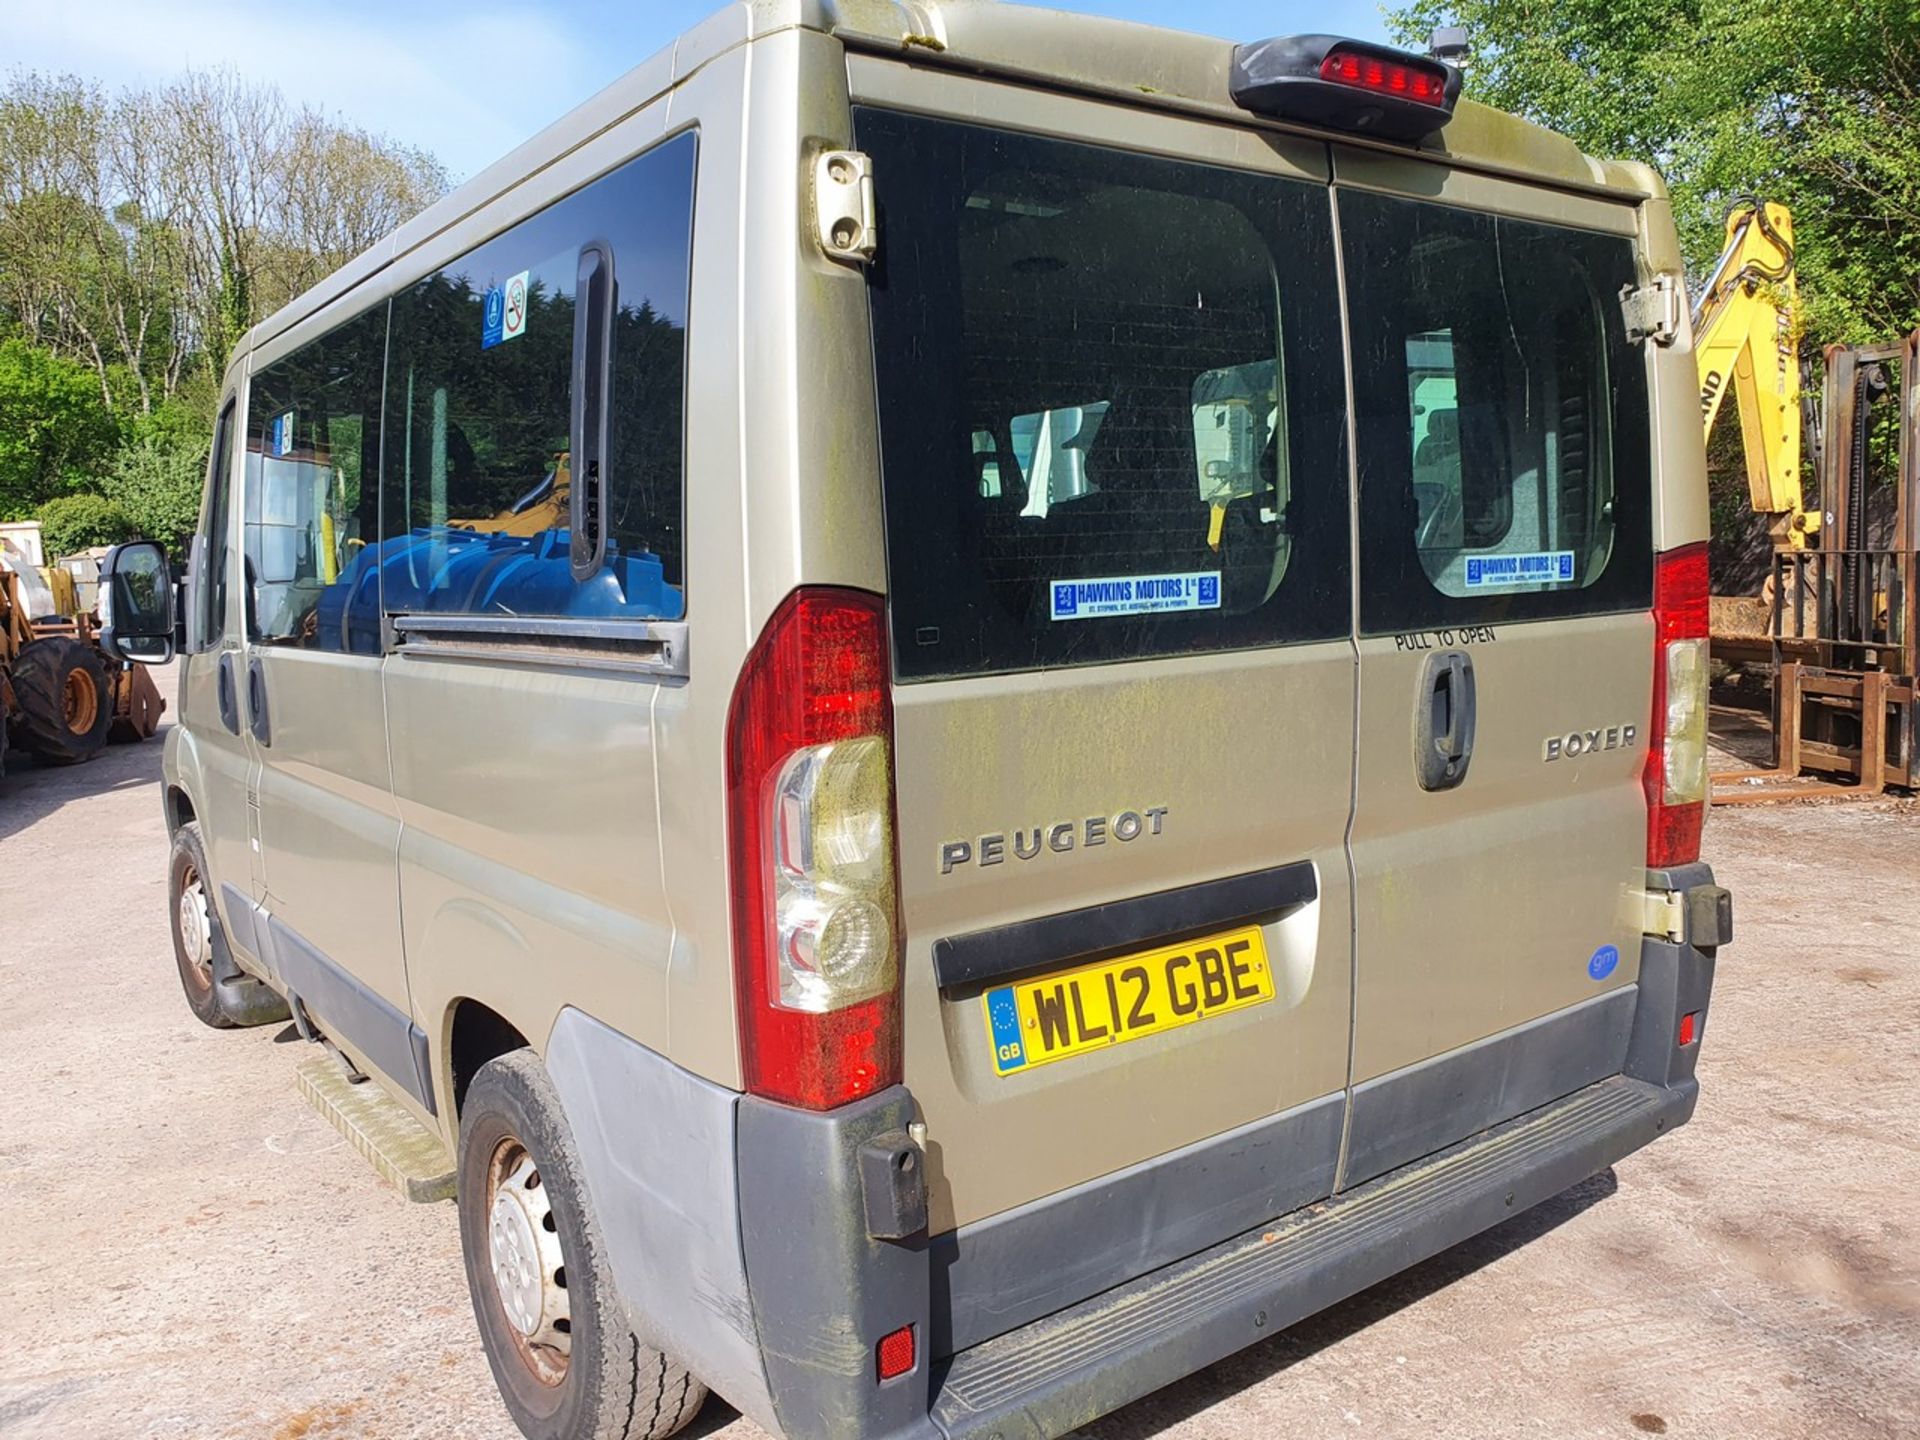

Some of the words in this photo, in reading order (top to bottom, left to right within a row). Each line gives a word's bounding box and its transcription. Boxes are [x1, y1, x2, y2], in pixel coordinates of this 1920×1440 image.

[1482, 557, 1517, 575] HAWKINS
[1520, 555, 1549, 573] MOTORS
[1078, 581, 1132, 604] HAWKINS
[1136, 578, 1182, 599] MOTORS
[1394, 632, 1432, 652] PULL
[1437, 629, 1455, 647] TO
[1459, 626, 1497, 644] OPEN
[1543, 725, 1636, 763] BOXER
[940, 807, 1168, 874] PEUGEOT
[1033, 966, 1155, 1052] WL12
[1165, 940, 1260, 1017] GBE
[1000, 1042, 1021, 1062] GB
